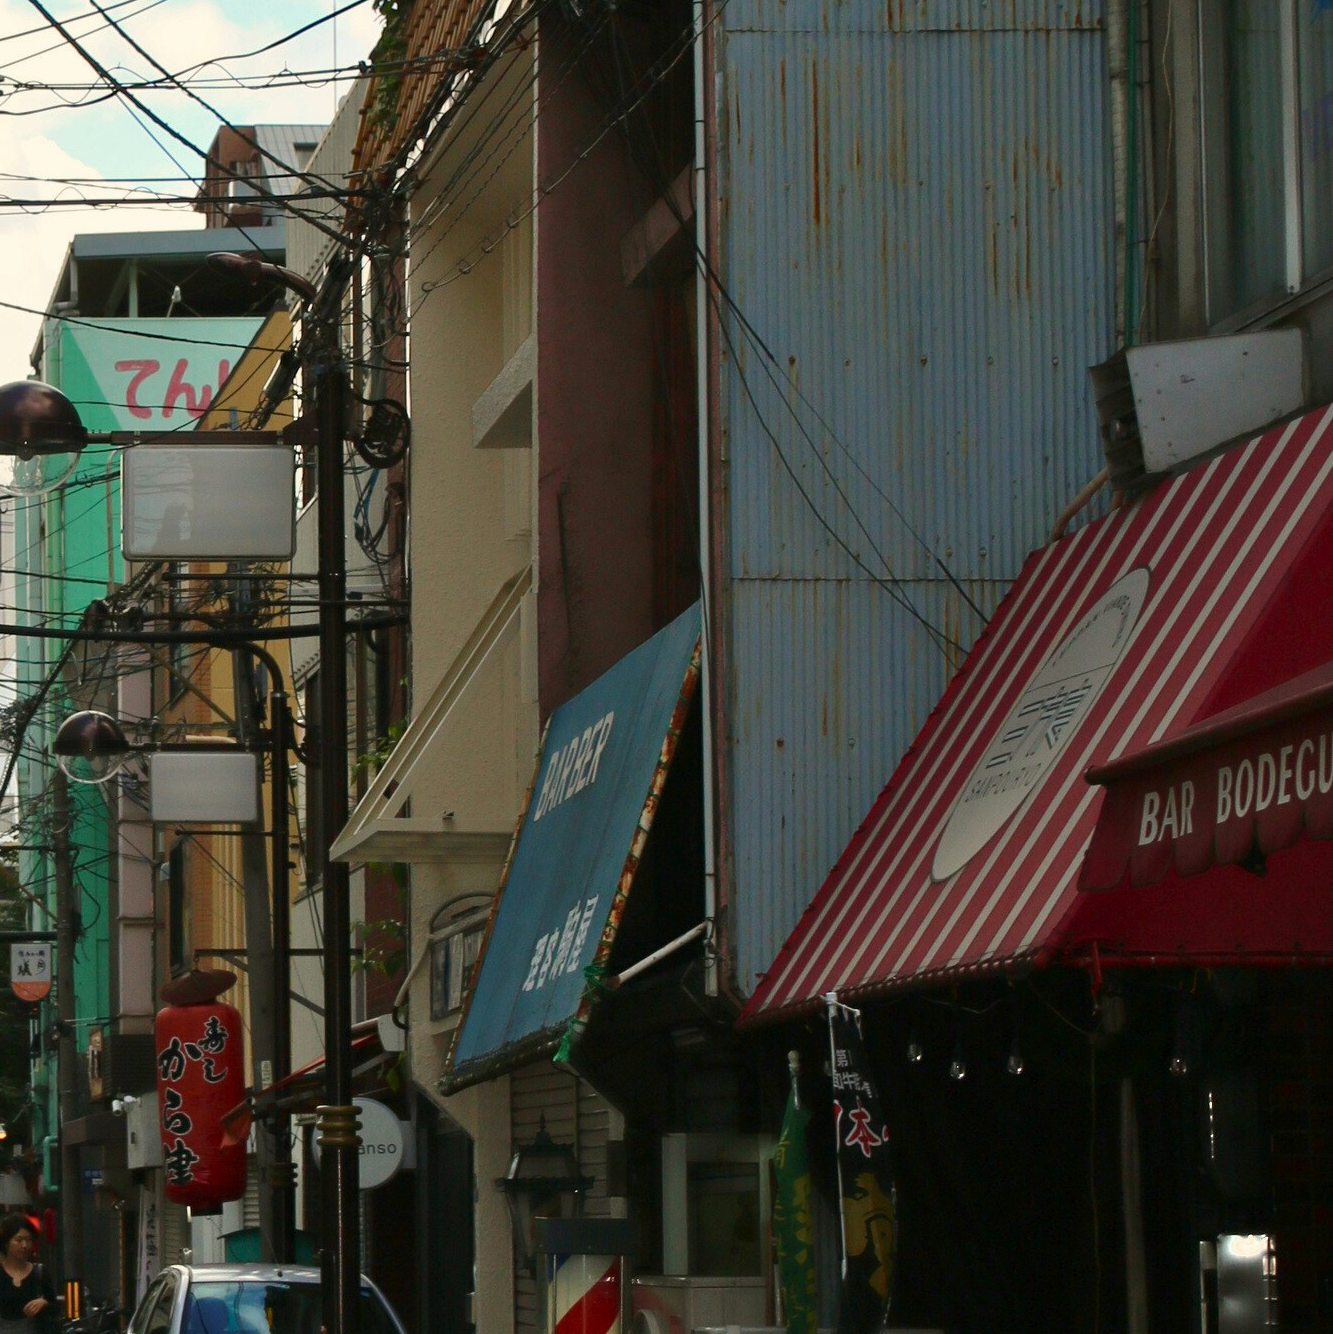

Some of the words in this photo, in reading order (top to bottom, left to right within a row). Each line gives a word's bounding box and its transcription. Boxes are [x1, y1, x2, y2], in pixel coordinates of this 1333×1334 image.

[533, 710, 615, 823] BARBER
[1138, 779, 1195, 847] BAR
[197, 1015, 229, 1085] 寿し
[157, 1036, 205, 1189] から津
